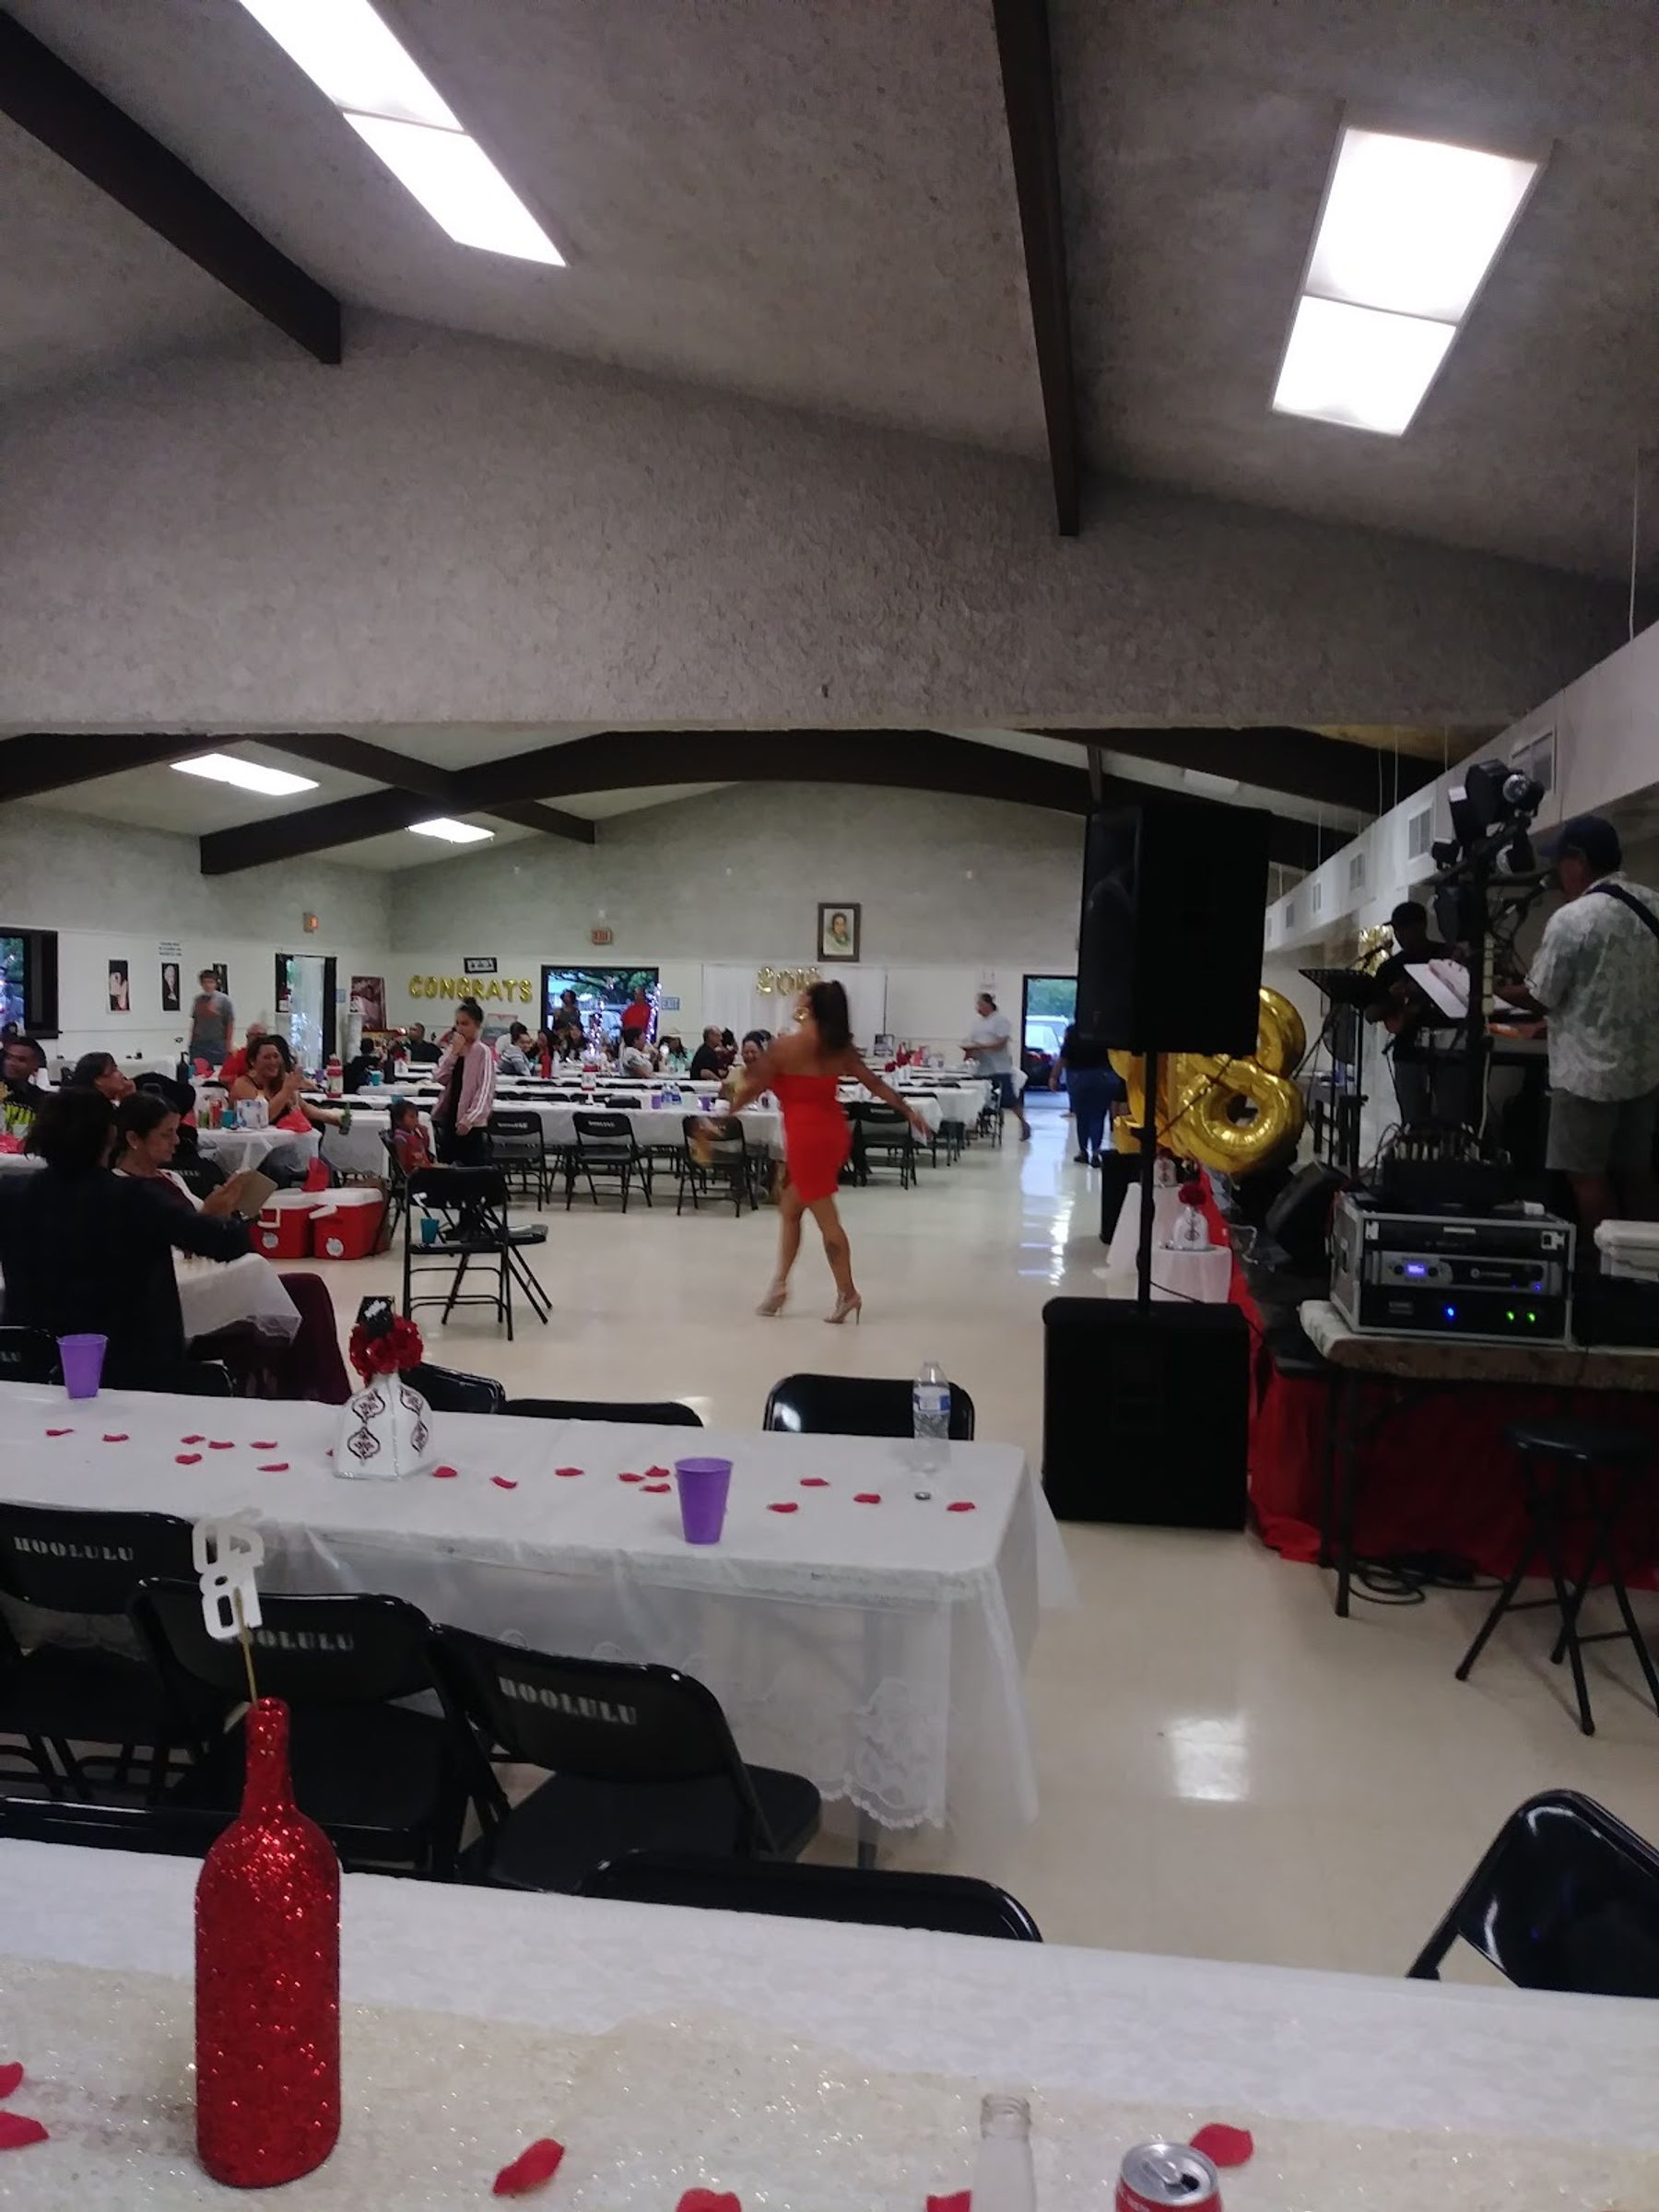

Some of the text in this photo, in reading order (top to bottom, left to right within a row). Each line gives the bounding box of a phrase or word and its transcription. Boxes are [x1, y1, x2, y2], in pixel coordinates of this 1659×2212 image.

[408, 974, 533, 1003] CONGRATS
[14, 1536, 135, 1561] HOOLULU
[240, 1628, 354, 1650] OLULU
[498, 1676, 638, 1725] HOOLULU
